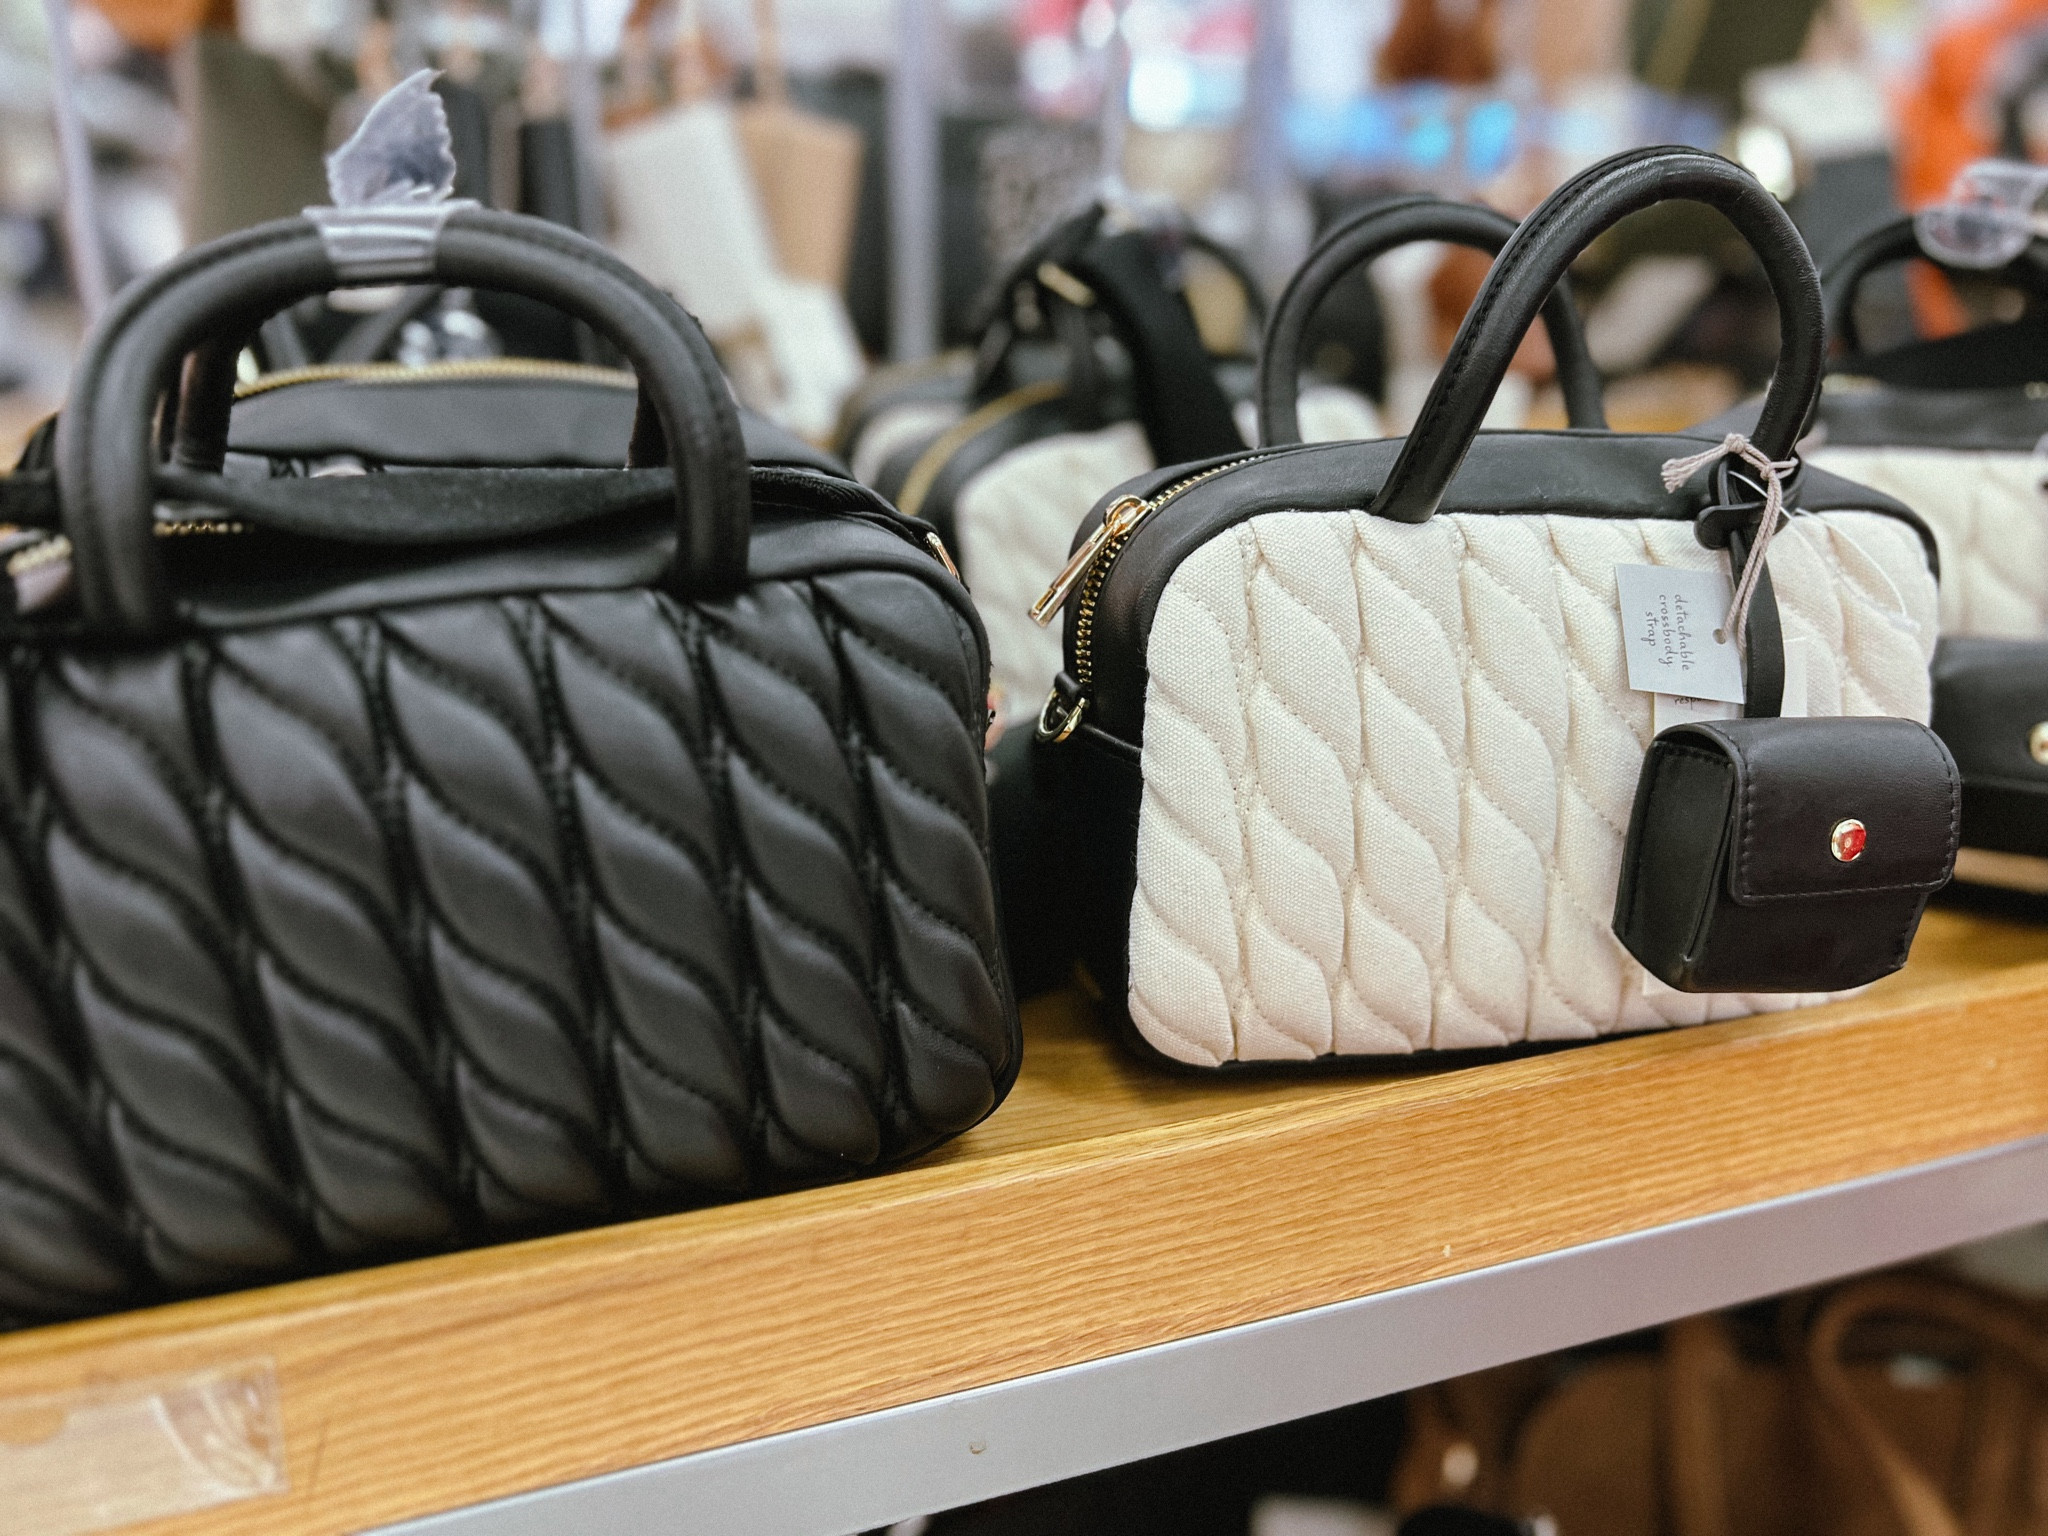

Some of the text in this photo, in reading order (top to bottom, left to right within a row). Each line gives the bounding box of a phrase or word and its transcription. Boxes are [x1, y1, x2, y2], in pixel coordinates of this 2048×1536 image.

[1641, 611, 1659, 647] strap
[1658, 594, 1677, 667] crossbody
[1674, 594, 1695, 671] detachable
